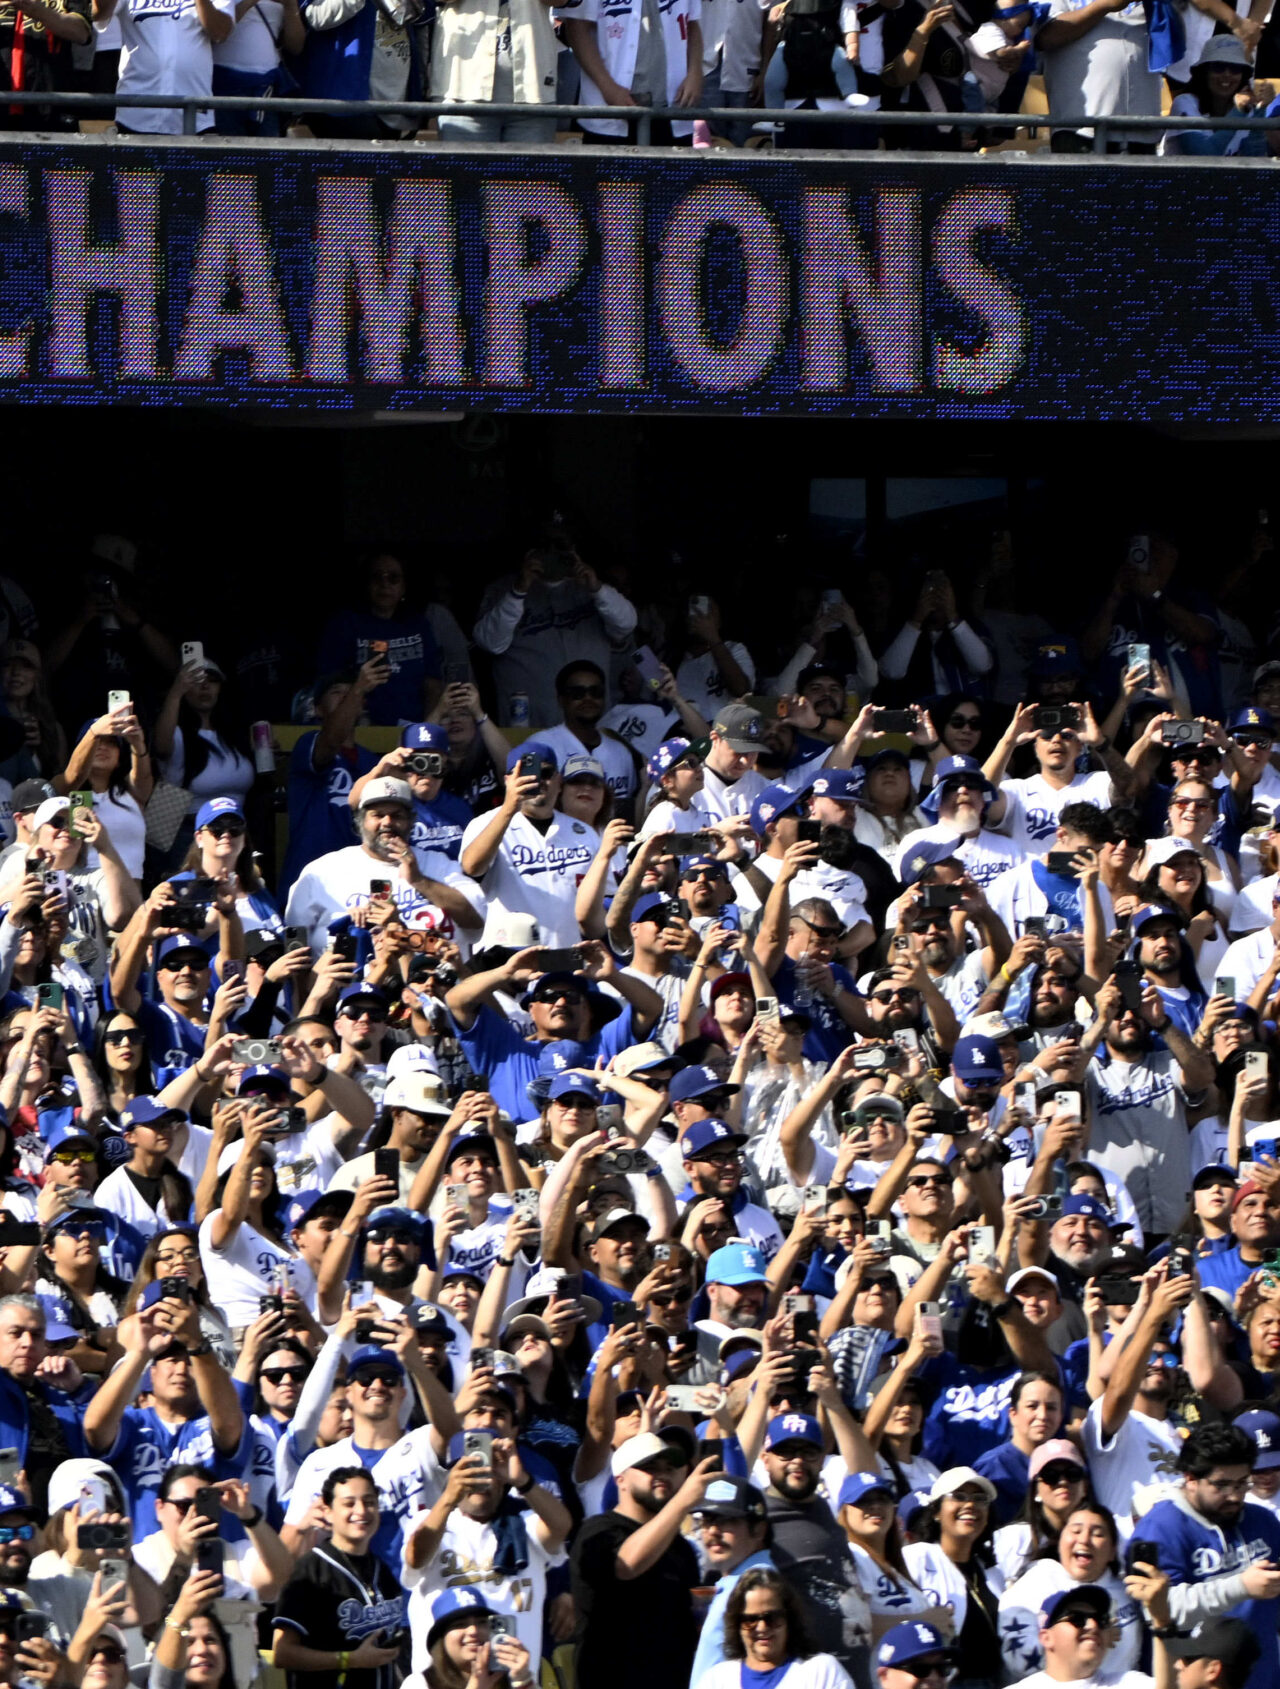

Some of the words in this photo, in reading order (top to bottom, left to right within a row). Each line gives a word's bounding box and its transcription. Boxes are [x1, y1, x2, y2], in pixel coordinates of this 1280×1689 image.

[1247, 709, 1258, 723] LA
[419, 727, 431, 741] LA
[952, 755, 965, 767] LA
[411, 823, 464, 850] Dodgers
[512, 845, 593, 875] Dodgers
[965, 861, 1014, 887] odgers
[659, 892, 671, 902] LA
[1148, 904, 1162, 915] LA
[176, 934, 190, 946] LA
[259, 930, 275, 941] LA
[360, 981, 374, 992] LA
[778, 1005, 793, 1016] LA
[552, 1053, 566, 1069] LA
[972, 1048, 985, 1064] LA
[256, 1064, 269, 1075] LA
[702, 1066, 717, 1080] LA
[1121, 1073, 1175, 1108] Angeles
[147, 1095, 164, 1107] LA
[712, 1121, 727, 1136] LA
[741, 1250, 756, 1267] LA
[1112, 1246, 1126, 1257] LA
[52, 1307, 67, 1322] LA
[782, 1415, 807, 1432] PR
[1255, 1429, 1270, 1448] LA
[454, 1587, 476, 1607] LA
[511, 1578, 532, 1612] 17
[914, 1624, 934, 1643] LA
